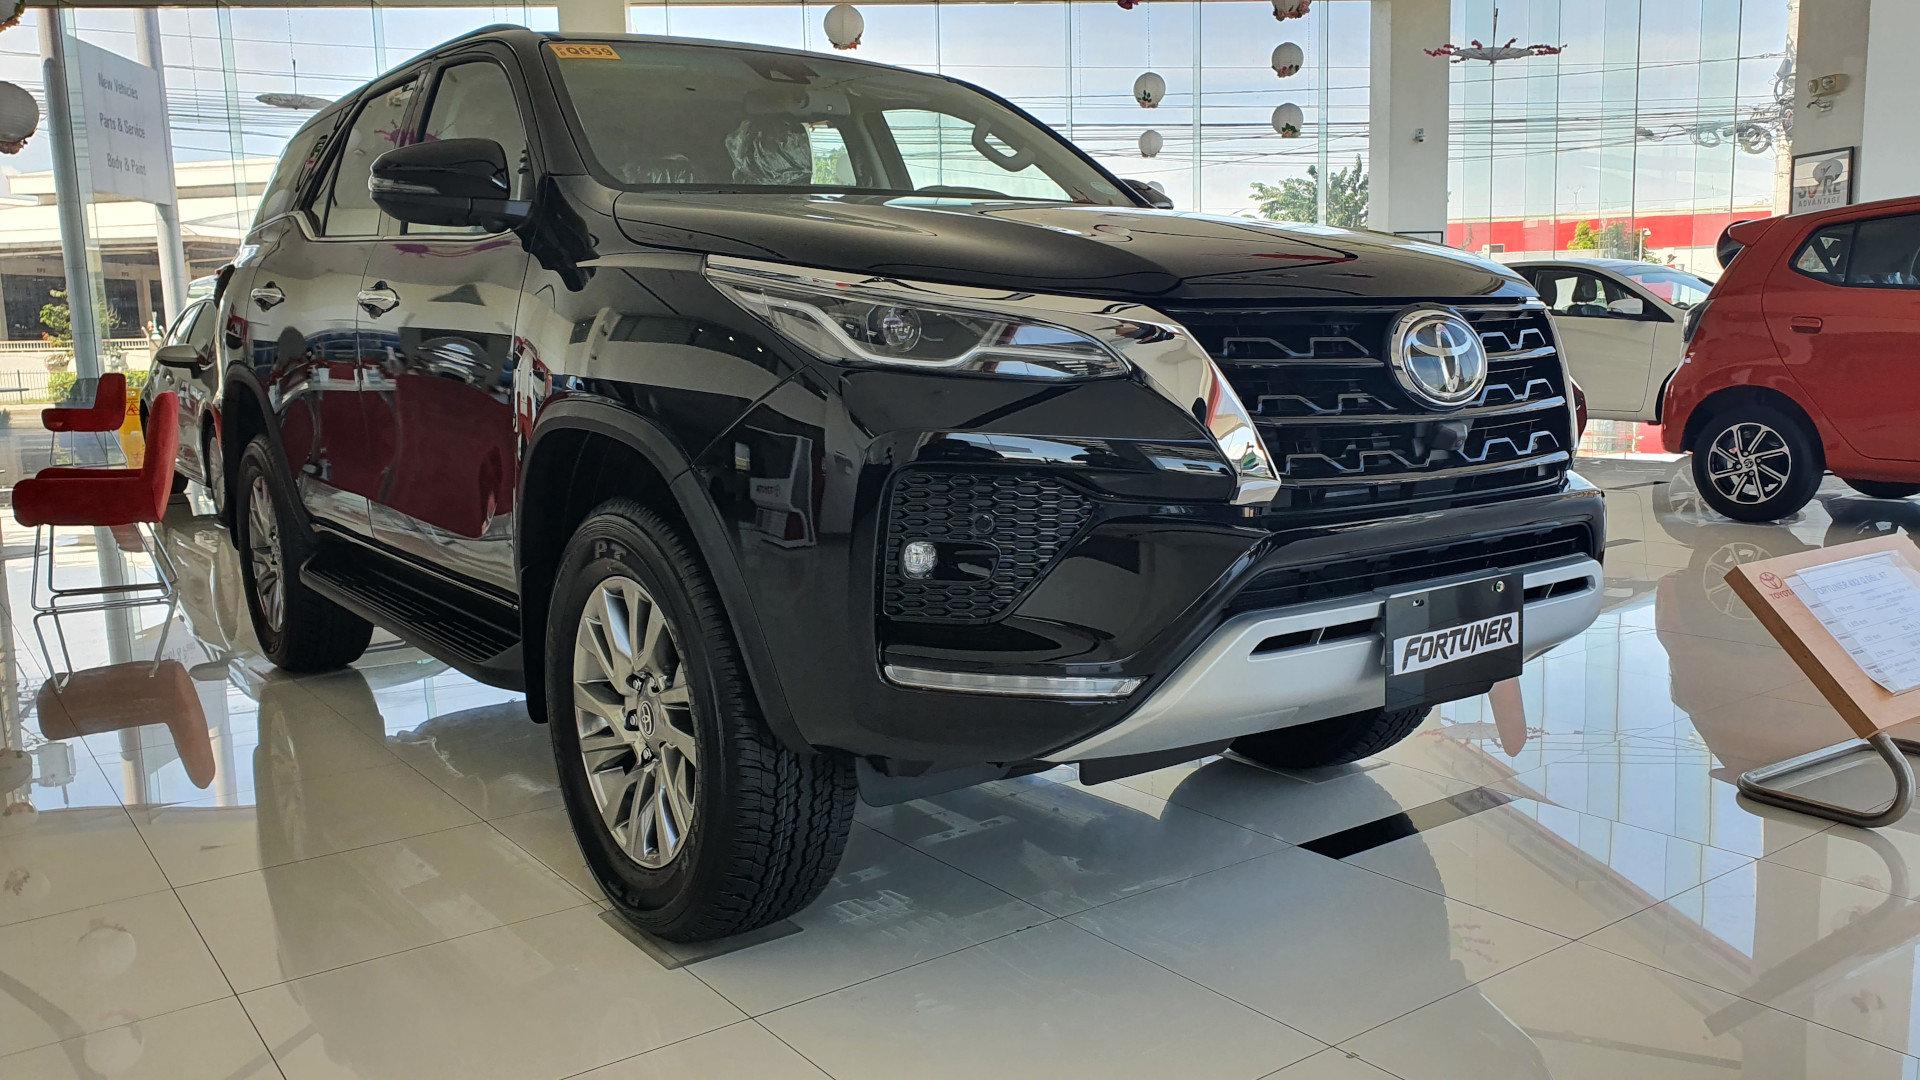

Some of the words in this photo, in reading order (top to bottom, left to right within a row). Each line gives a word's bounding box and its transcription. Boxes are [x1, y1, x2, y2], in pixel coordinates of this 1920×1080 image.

[98, 72, 113, 91] New
[113, 79, 139, 100] Vehicles
[99, 112, 116, 131] Parts
[117, 118, 123, 132] &
[124, 119, 146, 139] Service
[106, 152, 122, 172] Body
[124, 157, 130, 172] &
[131, 158, 147, 176] Paint
[1798, 196, 1841, 207] ADVANTAGE
[1401, 616, 1513, 672] FORTUNER
